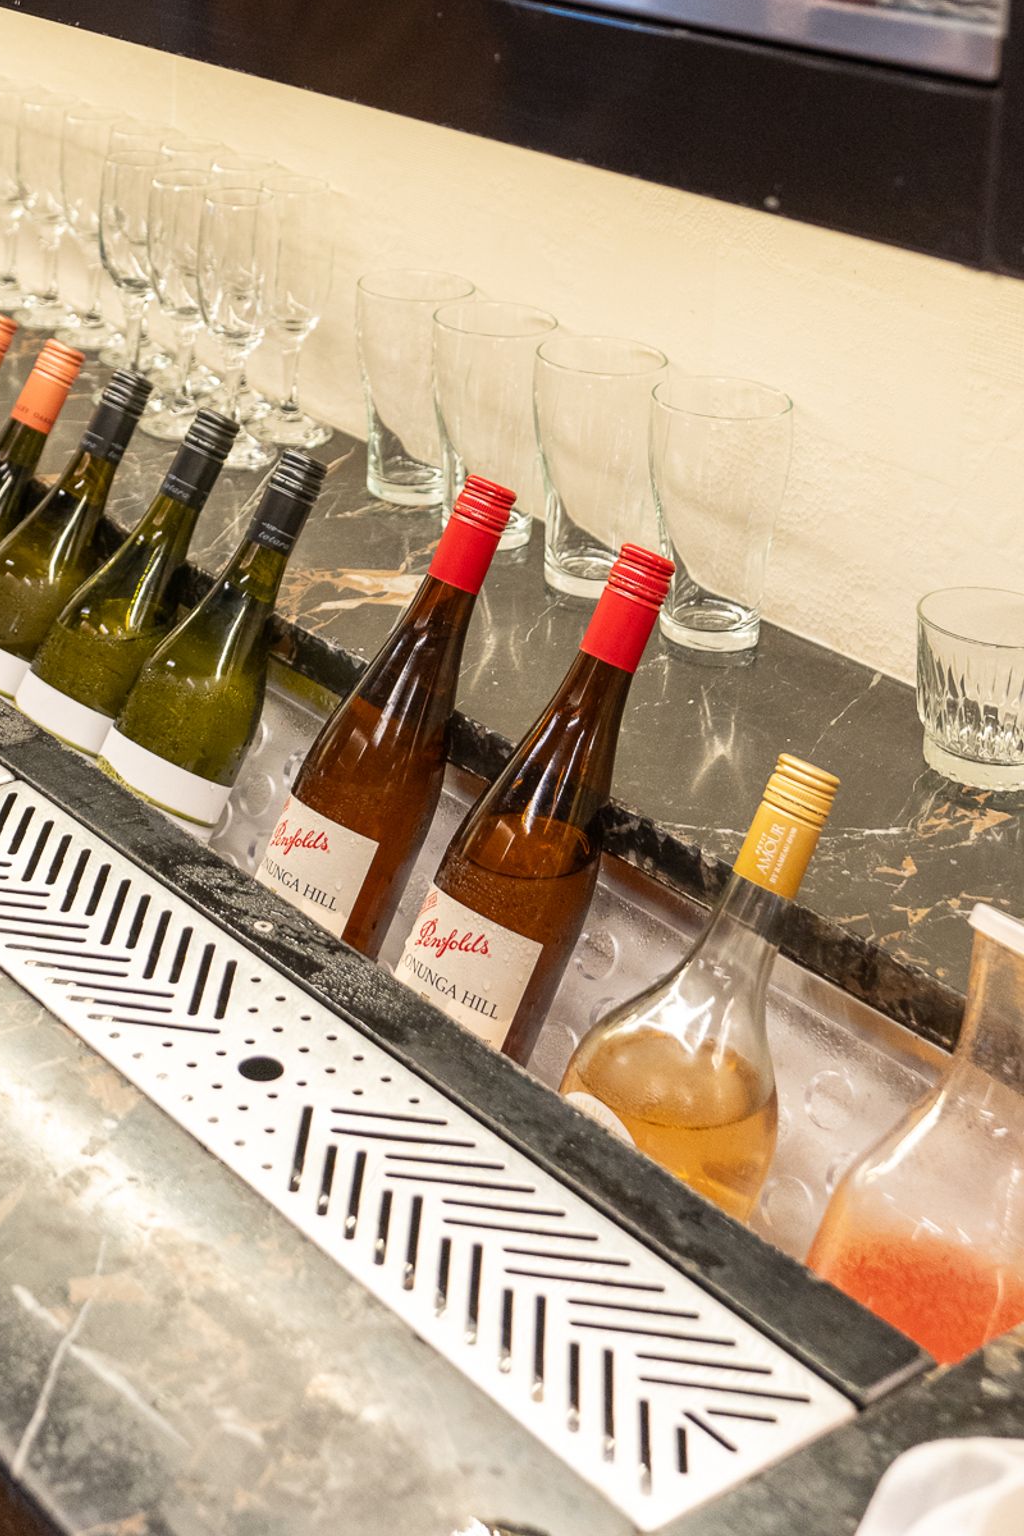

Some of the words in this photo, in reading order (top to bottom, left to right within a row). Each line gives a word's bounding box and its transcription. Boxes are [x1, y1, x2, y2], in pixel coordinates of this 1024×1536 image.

[756, 822, 786, 876] AMOUR
[302, 883, 337, 912] HILL
[414, 918, 490, 959] Penfolds
[404, 952, 457, 1000] ONUNGA
[460, 990, 498, 1020] HILL
